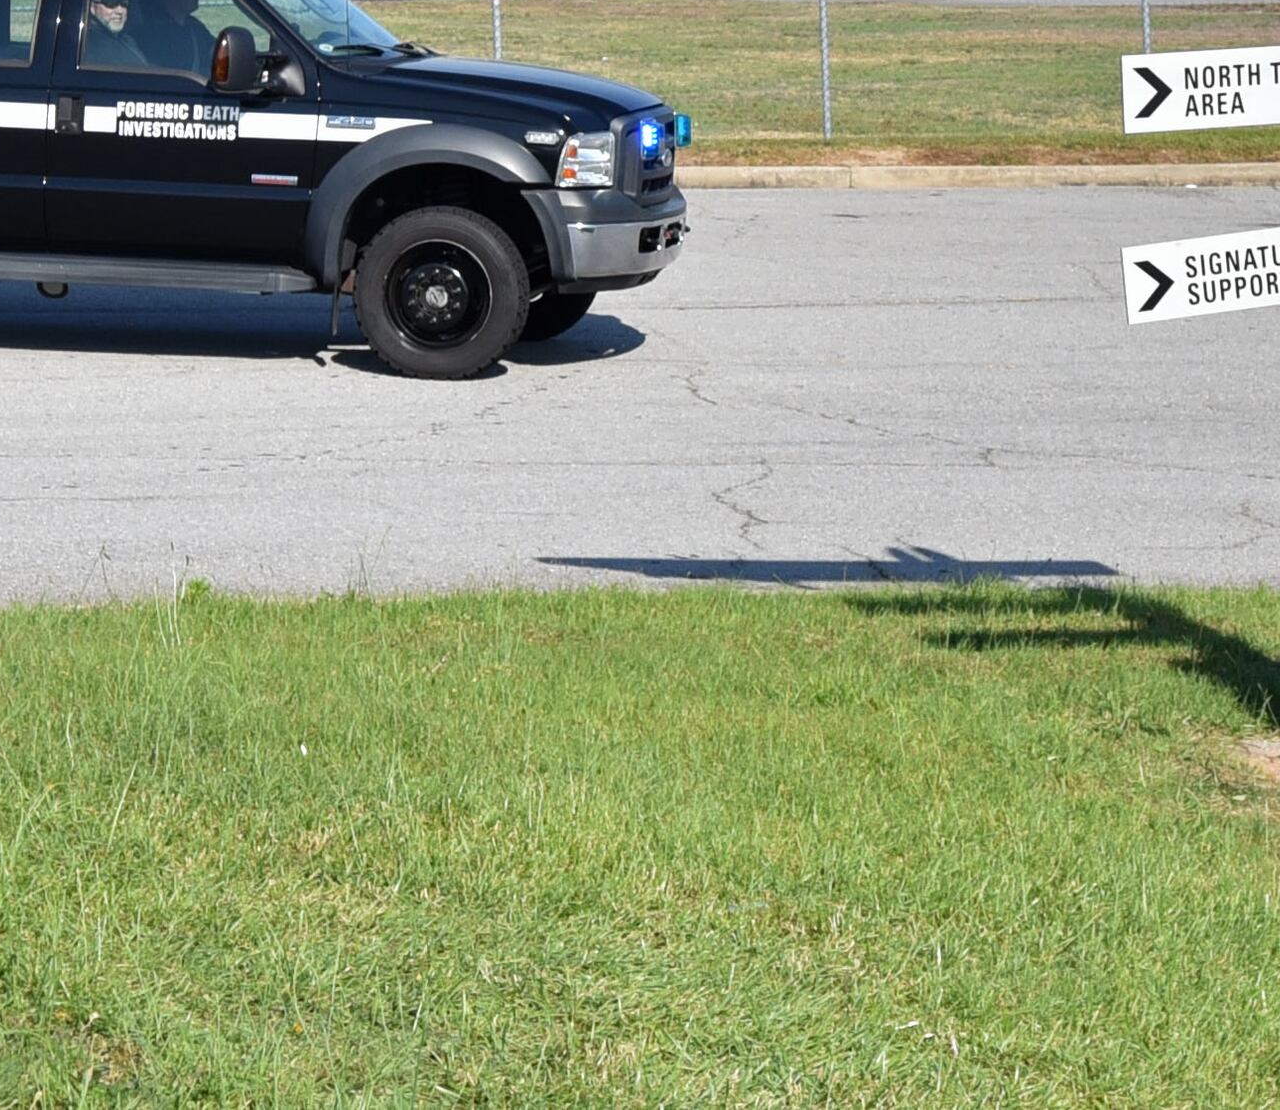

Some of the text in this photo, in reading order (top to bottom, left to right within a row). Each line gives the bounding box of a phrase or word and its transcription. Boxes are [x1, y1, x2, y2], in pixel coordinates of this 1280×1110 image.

[1184, 63, 1261, 90] NORTH
[116, 101, 240, 121] FORENSIC DEATH
[1185, 92, 1245, 117] AREA
[118, 120, 237, 141] INVESTIGATIONS
